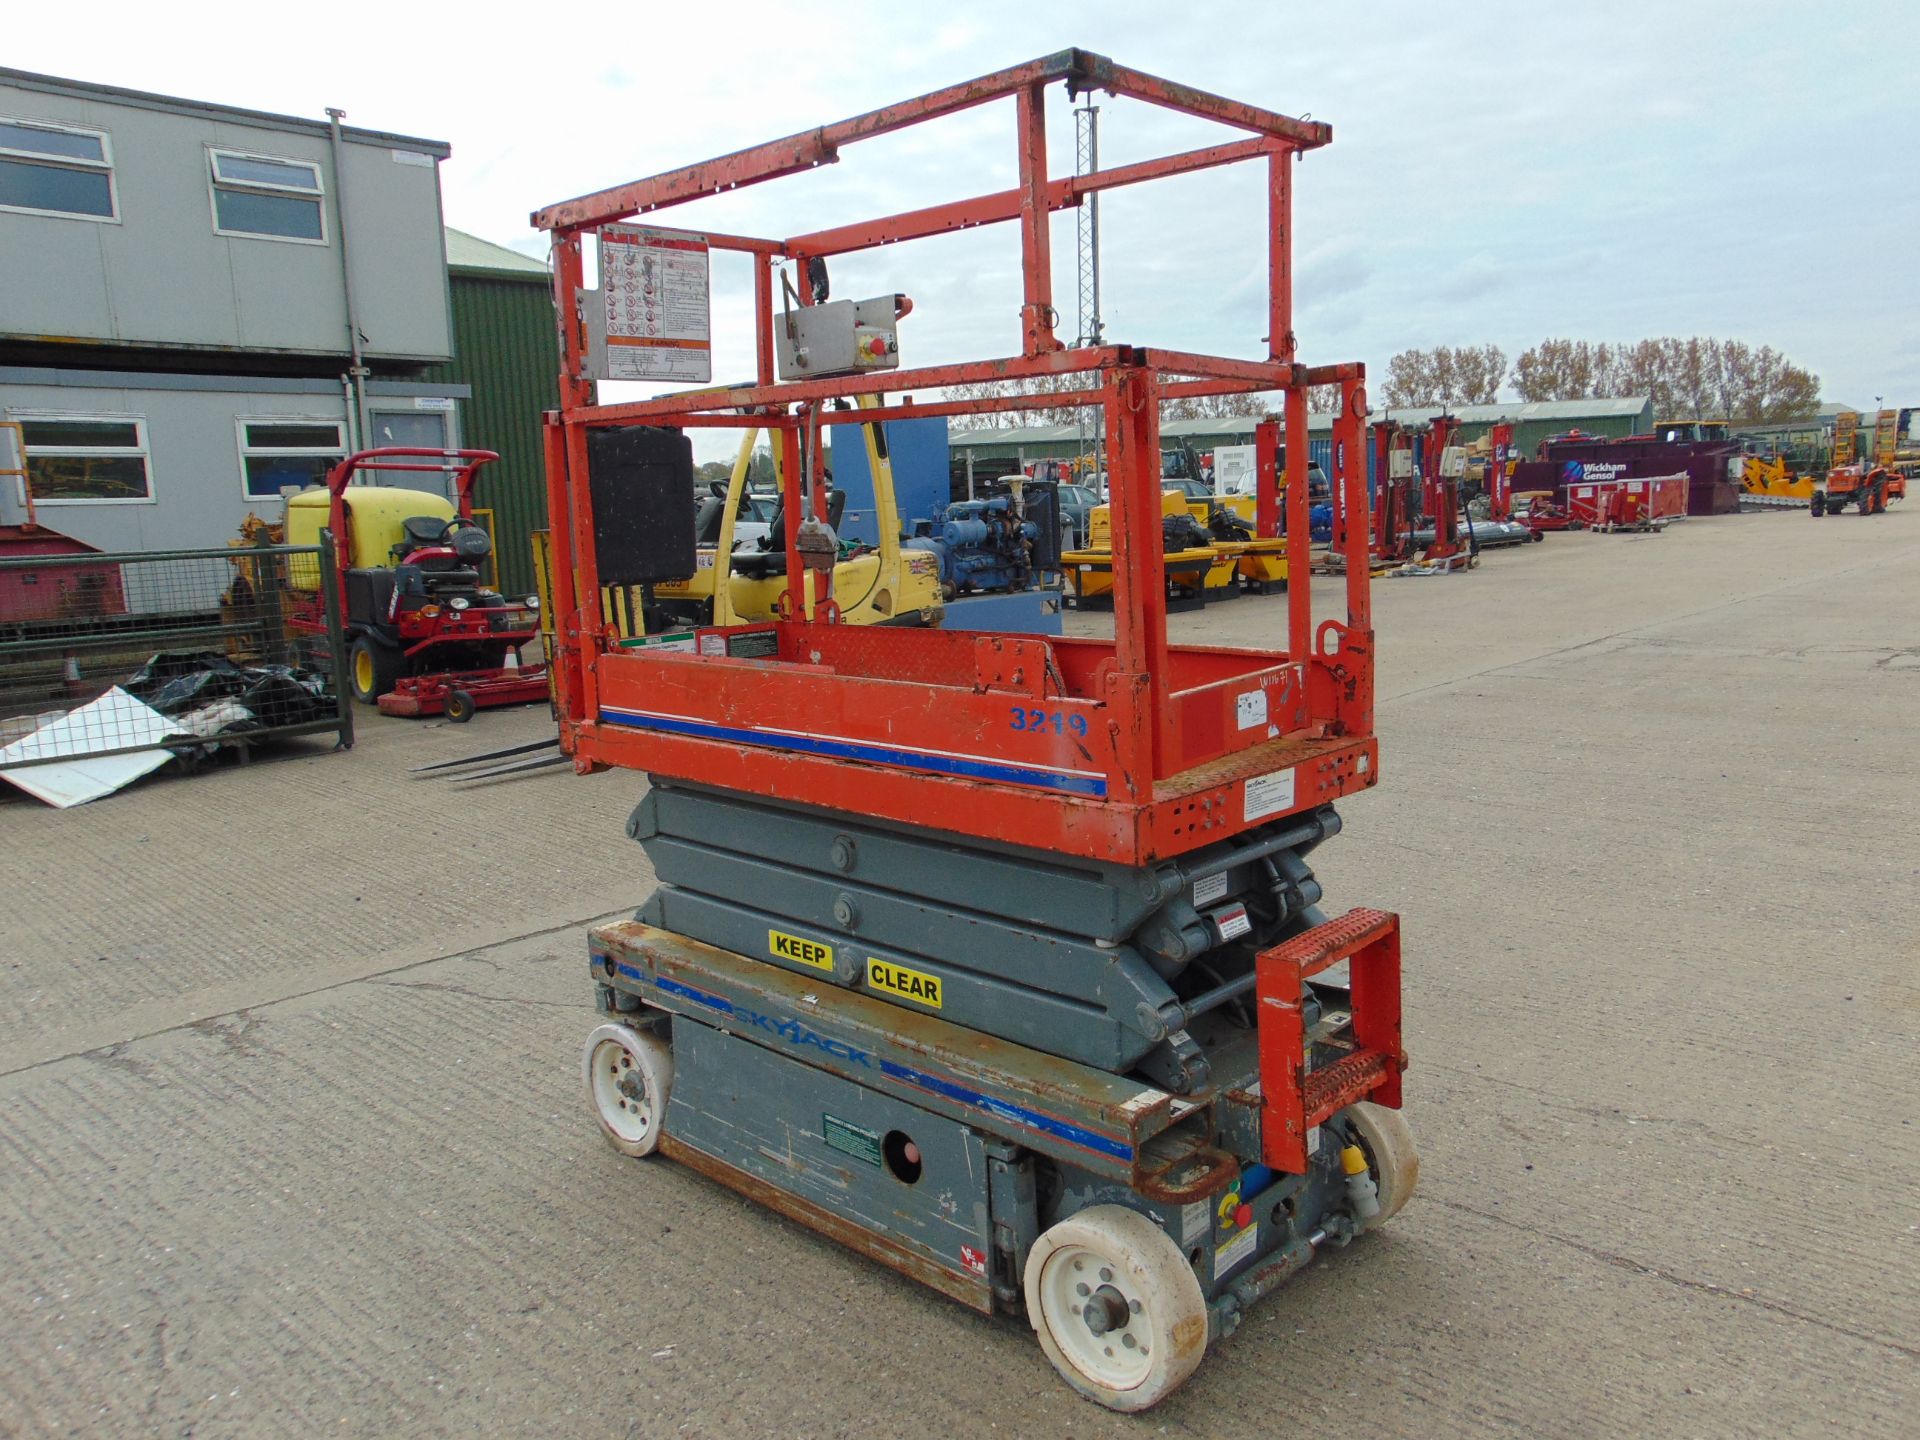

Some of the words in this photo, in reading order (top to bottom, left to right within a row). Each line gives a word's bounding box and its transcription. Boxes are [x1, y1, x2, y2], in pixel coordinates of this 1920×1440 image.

[1583, 463, 1627, 472] Wickham
[1583, 472, 1616, 480] Gensol
[1009, 706, 1089, 737] 3219
[776, 935, 826, 963] KEEP
[871, 964, 938, 1002] CLEAR
[734, 1005, 871, 1068] SKYJACK
